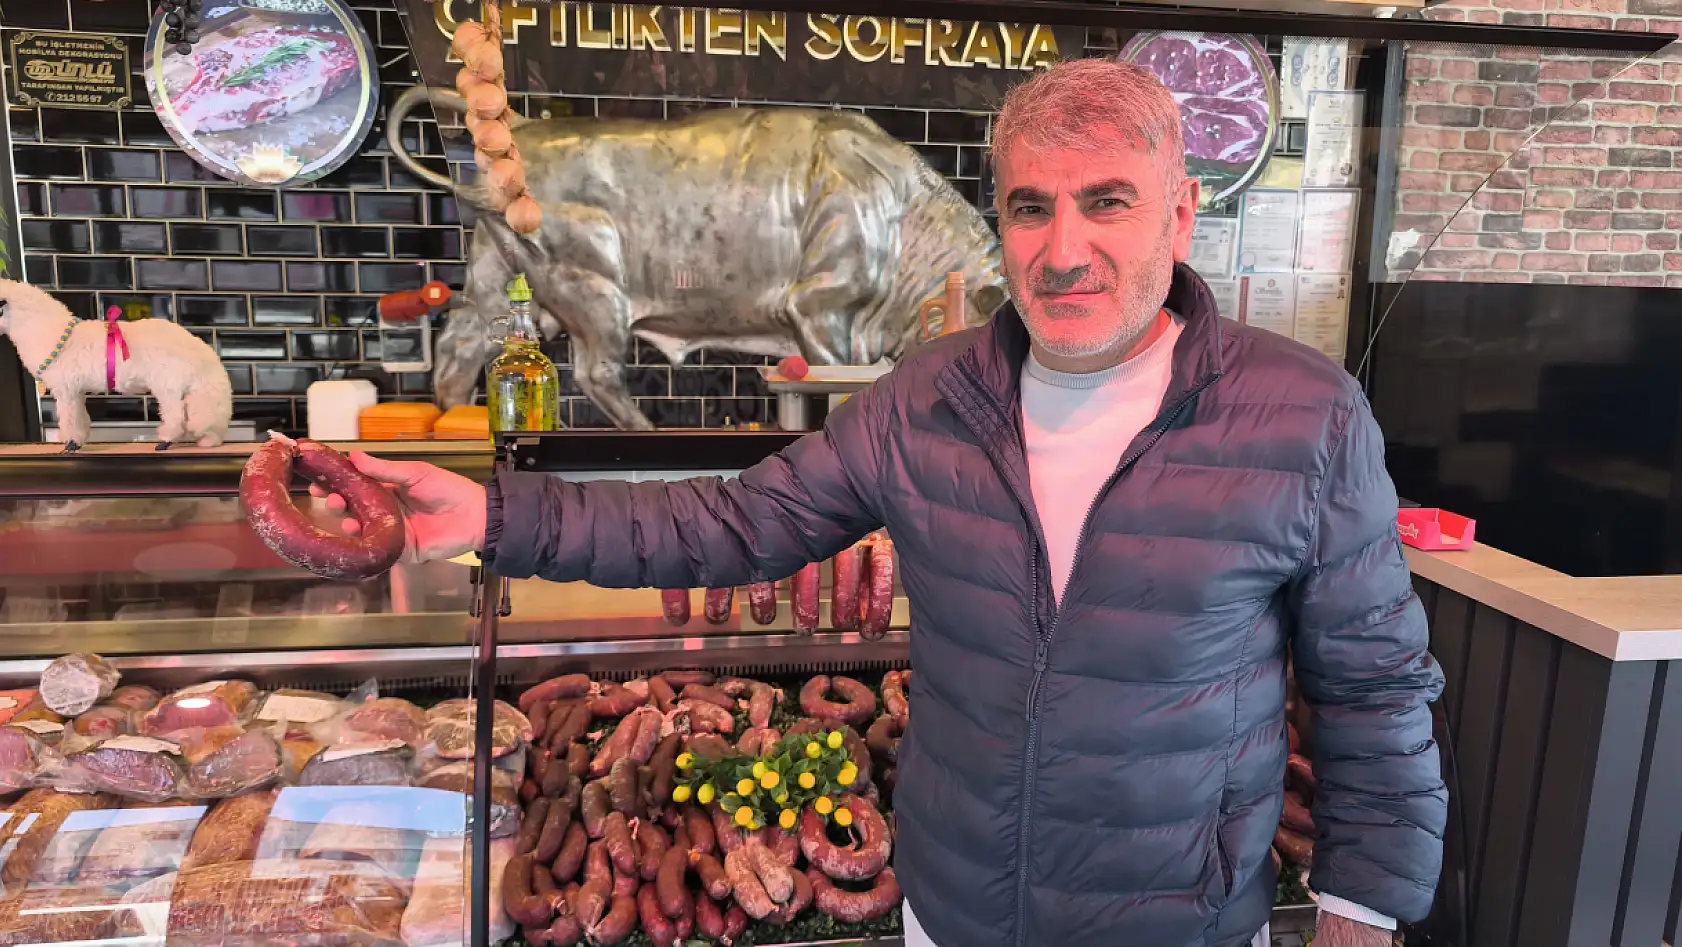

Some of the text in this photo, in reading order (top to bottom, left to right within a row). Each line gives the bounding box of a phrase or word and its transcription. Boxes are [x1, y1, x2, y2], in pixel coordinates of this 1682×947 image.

[35, 39, 48, 47] BU
[803, 12, 1059, 71] SOFRAYA
[58, 49, 123, 60] DEKORASYONU
[20, 82, 73, 91] TARAFINDAN
